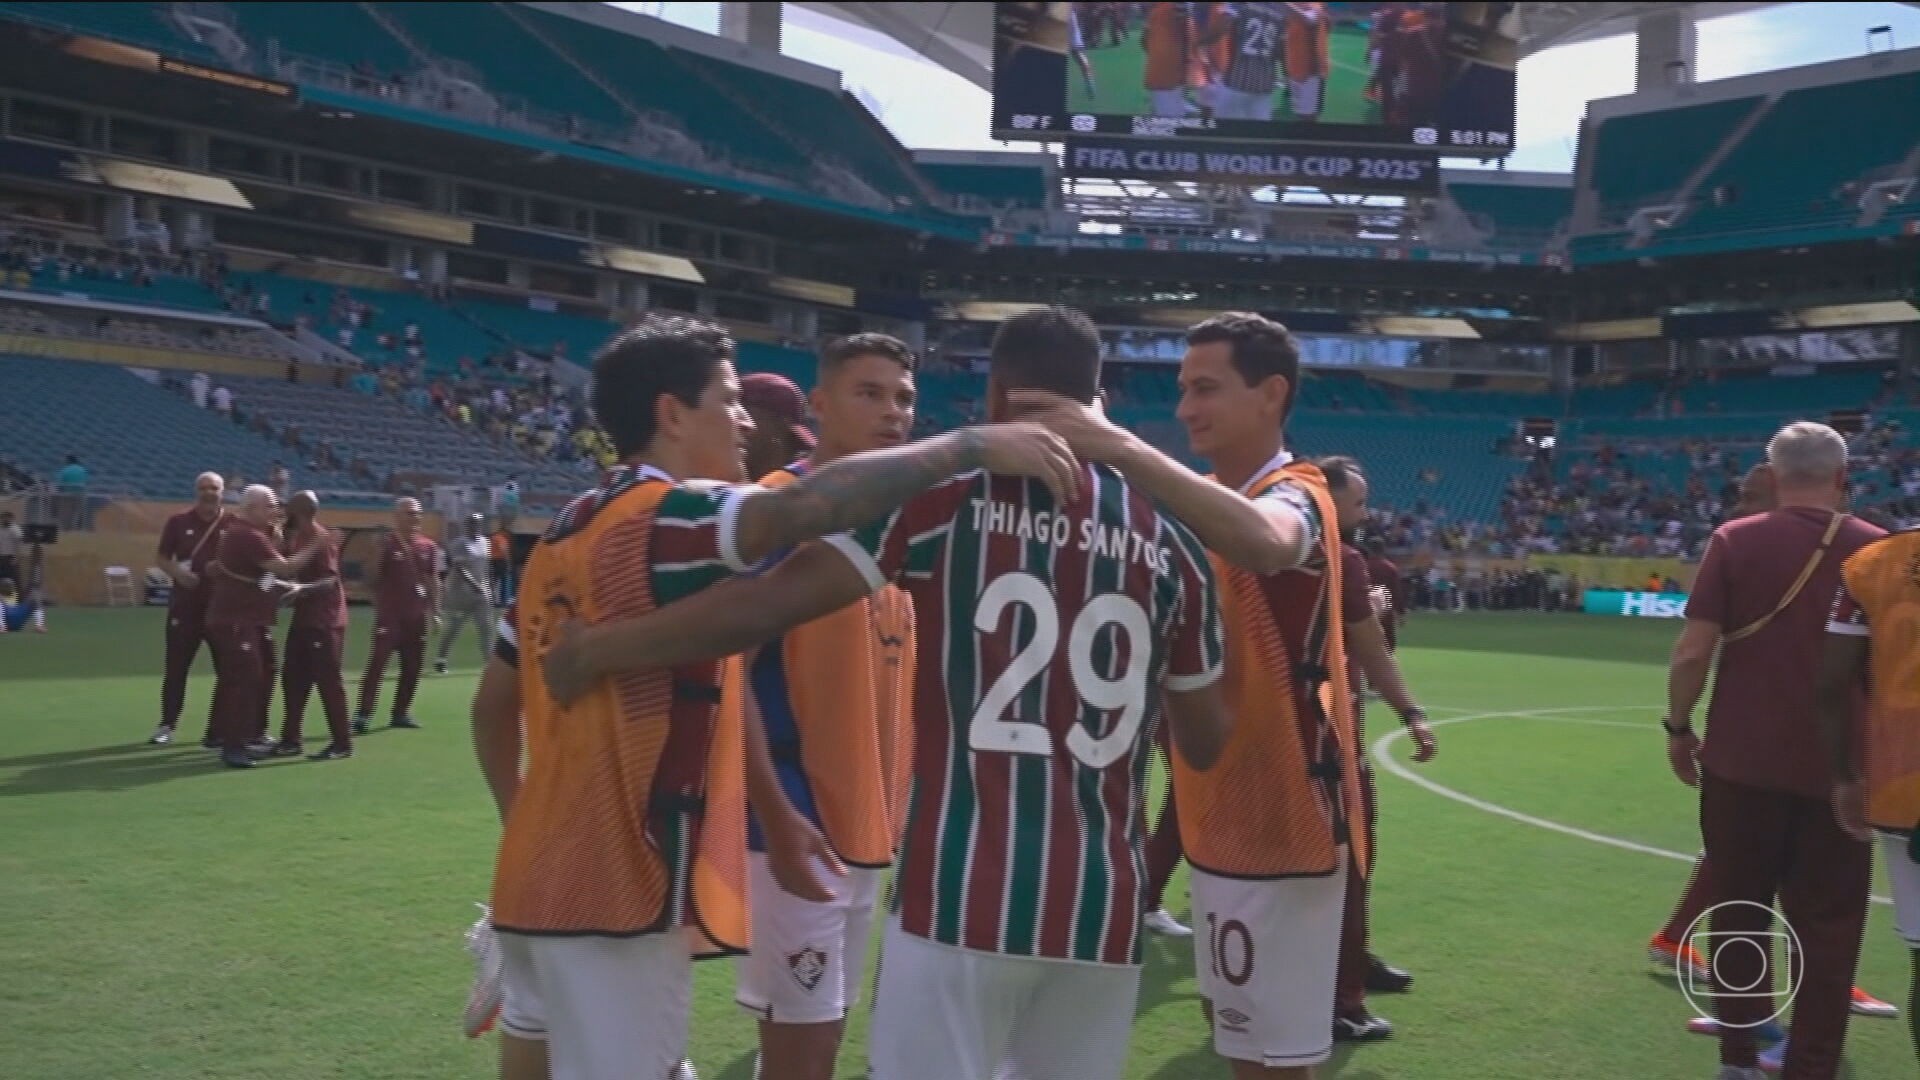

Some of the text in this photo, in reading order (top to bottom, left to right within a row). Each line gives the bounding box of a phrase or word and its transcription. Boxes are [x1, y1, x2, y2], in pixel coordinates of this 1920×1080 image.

[1074, 148, 1130, 169] FIFA
[1134, 151, 1200, 171] CLUB
[1205, 154, 1297, 176] WORLD
[1302, 157, 1352, 177] CUP
[971, 499, 1172, 577] THIAGO SANTOS
[968, 571, 1153, 769] 29
[1206, 911, 1255, 986] 10
